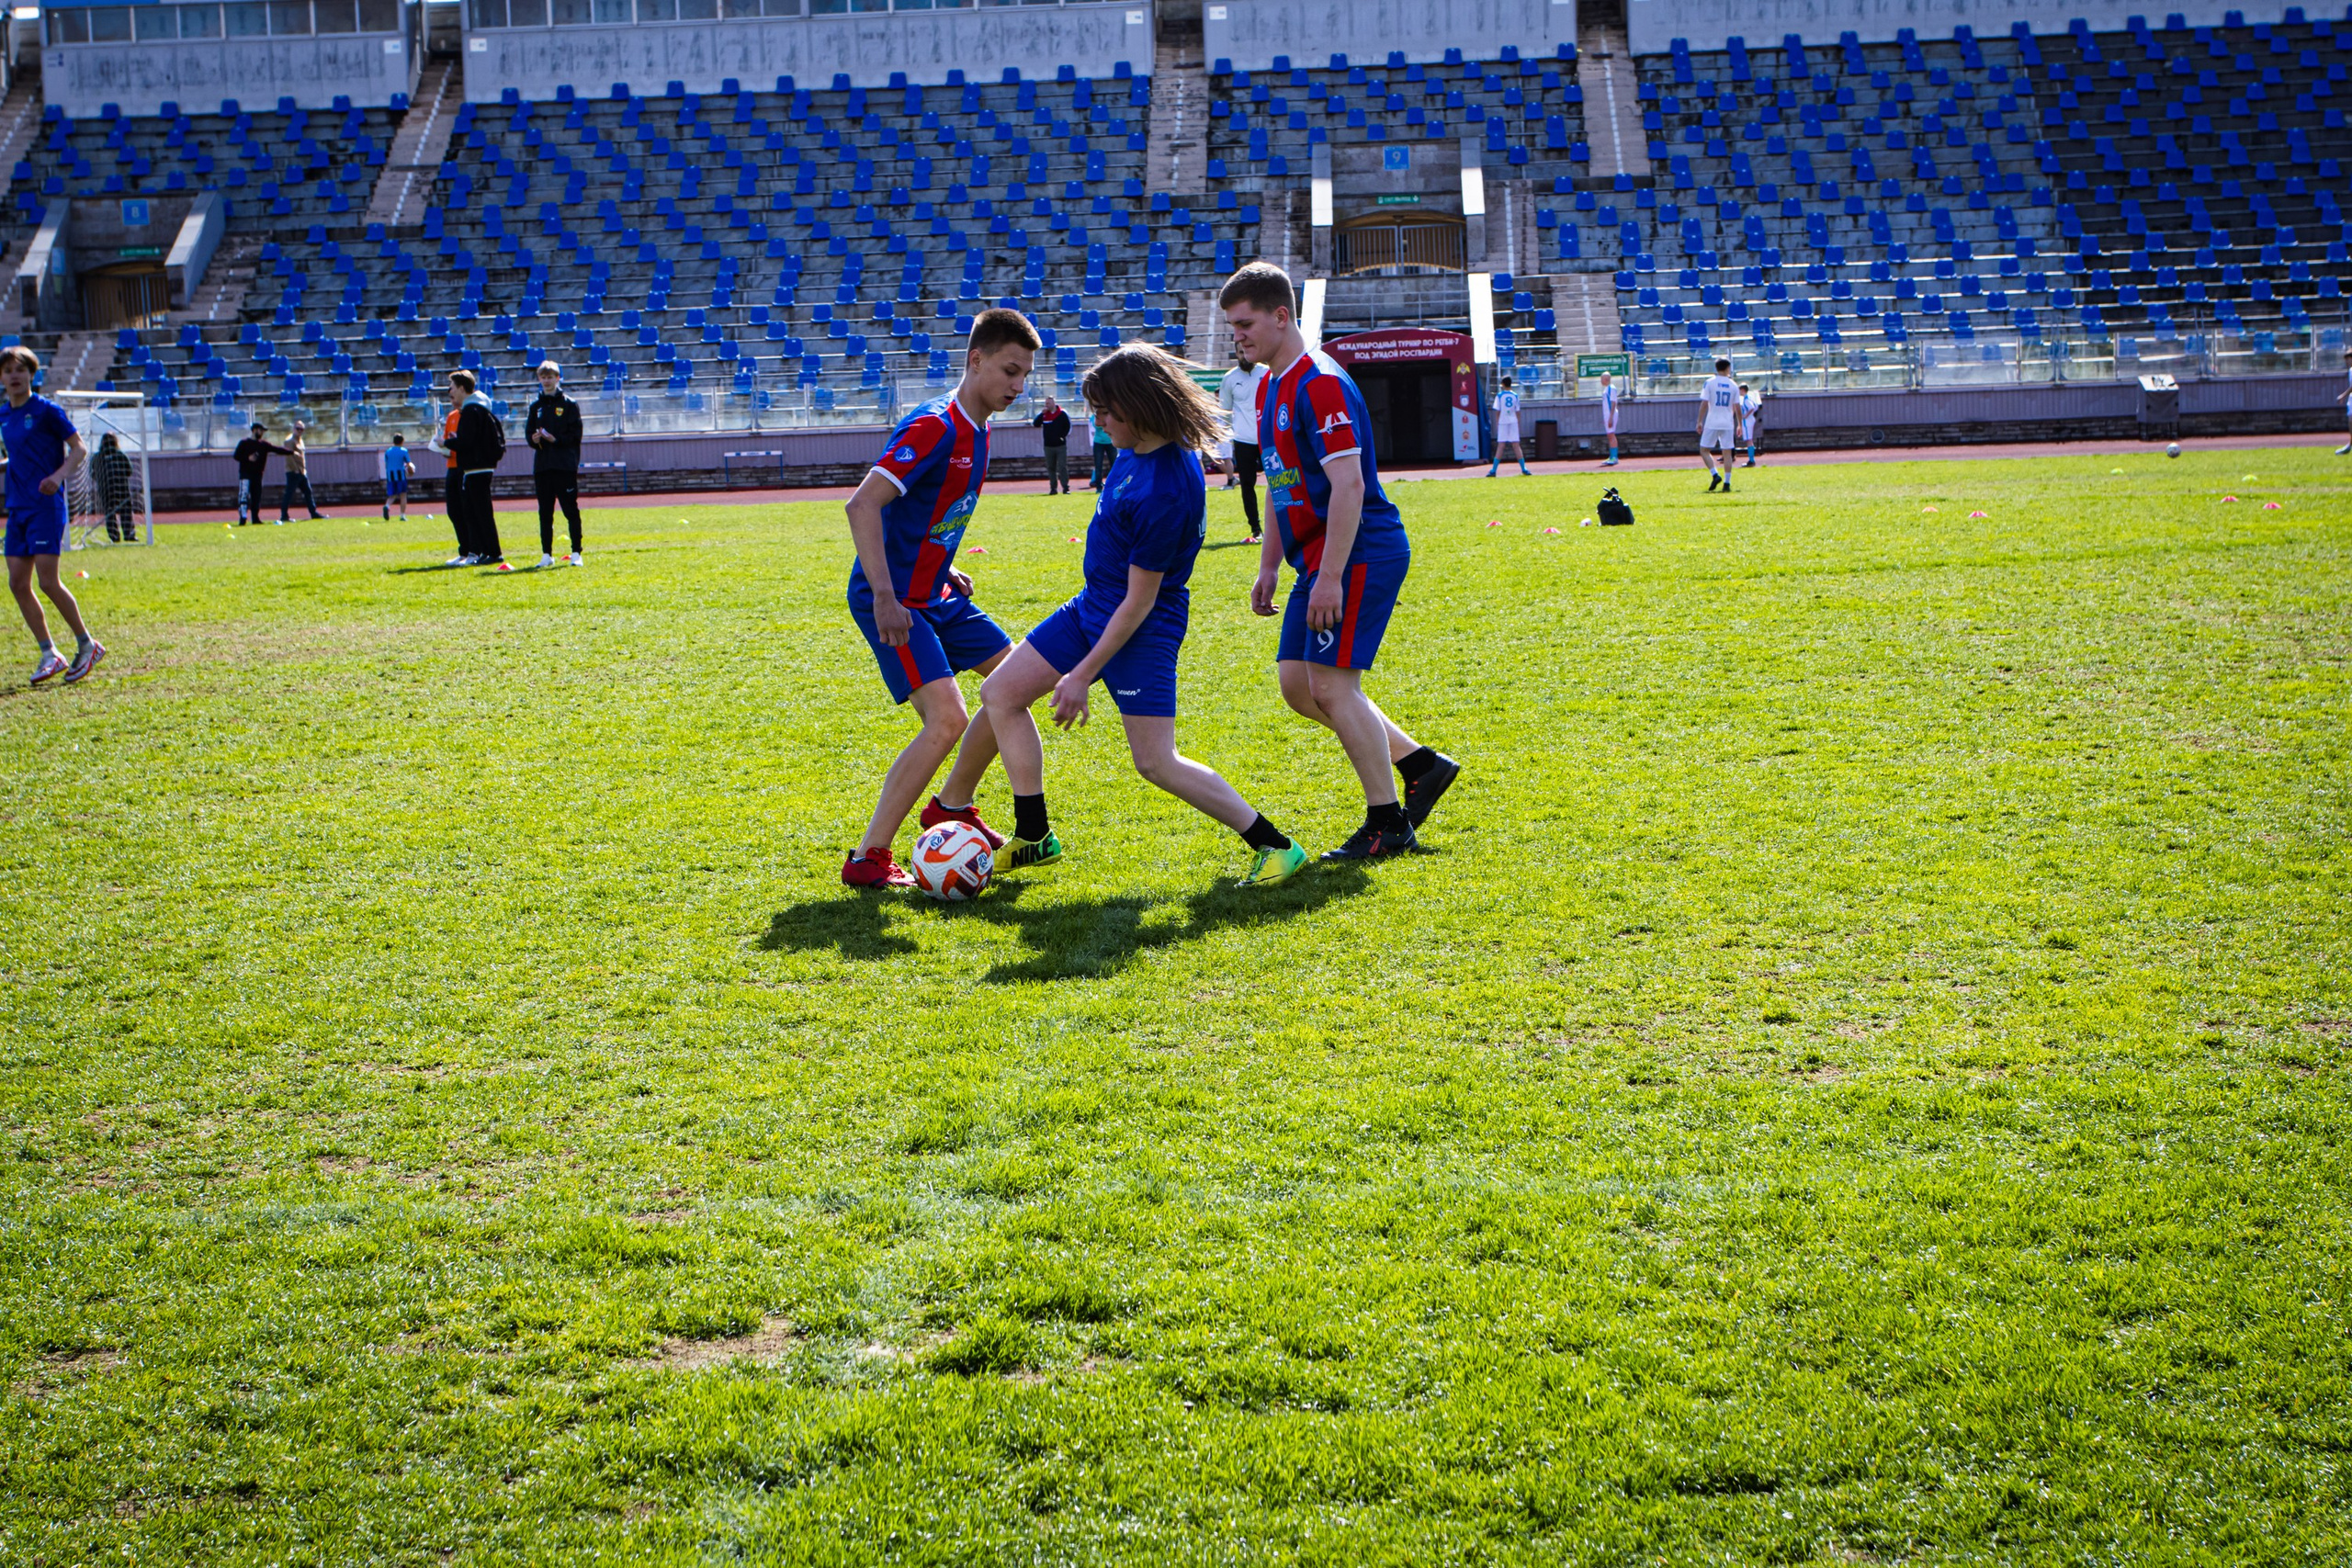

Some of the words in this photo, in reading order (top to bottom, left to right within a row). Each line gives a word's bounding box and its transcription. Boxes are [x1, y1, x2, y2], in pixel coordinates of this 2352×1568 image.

[1392, 151, 1401, 164] 9
[131, 207, 139, 218] 8
[1338, 341, 1396, 351] МЕЖДУНАРОДНЫЙ
[1397, 339, 1421, 347] ТУРНИР
[1354, 351, 1370, 360] ПОД
[1372, 349, 1398, 359] ЭГИДОЙ
[1399, 348, 1442, 357] РОСГВАРДИИ
[1505, 396, 1513, 408] 8
[1715, 390, 1731, 407] 10
[1317, 628, 1334, 653] 9
[1012, 837, 1055, 869] NIKE
